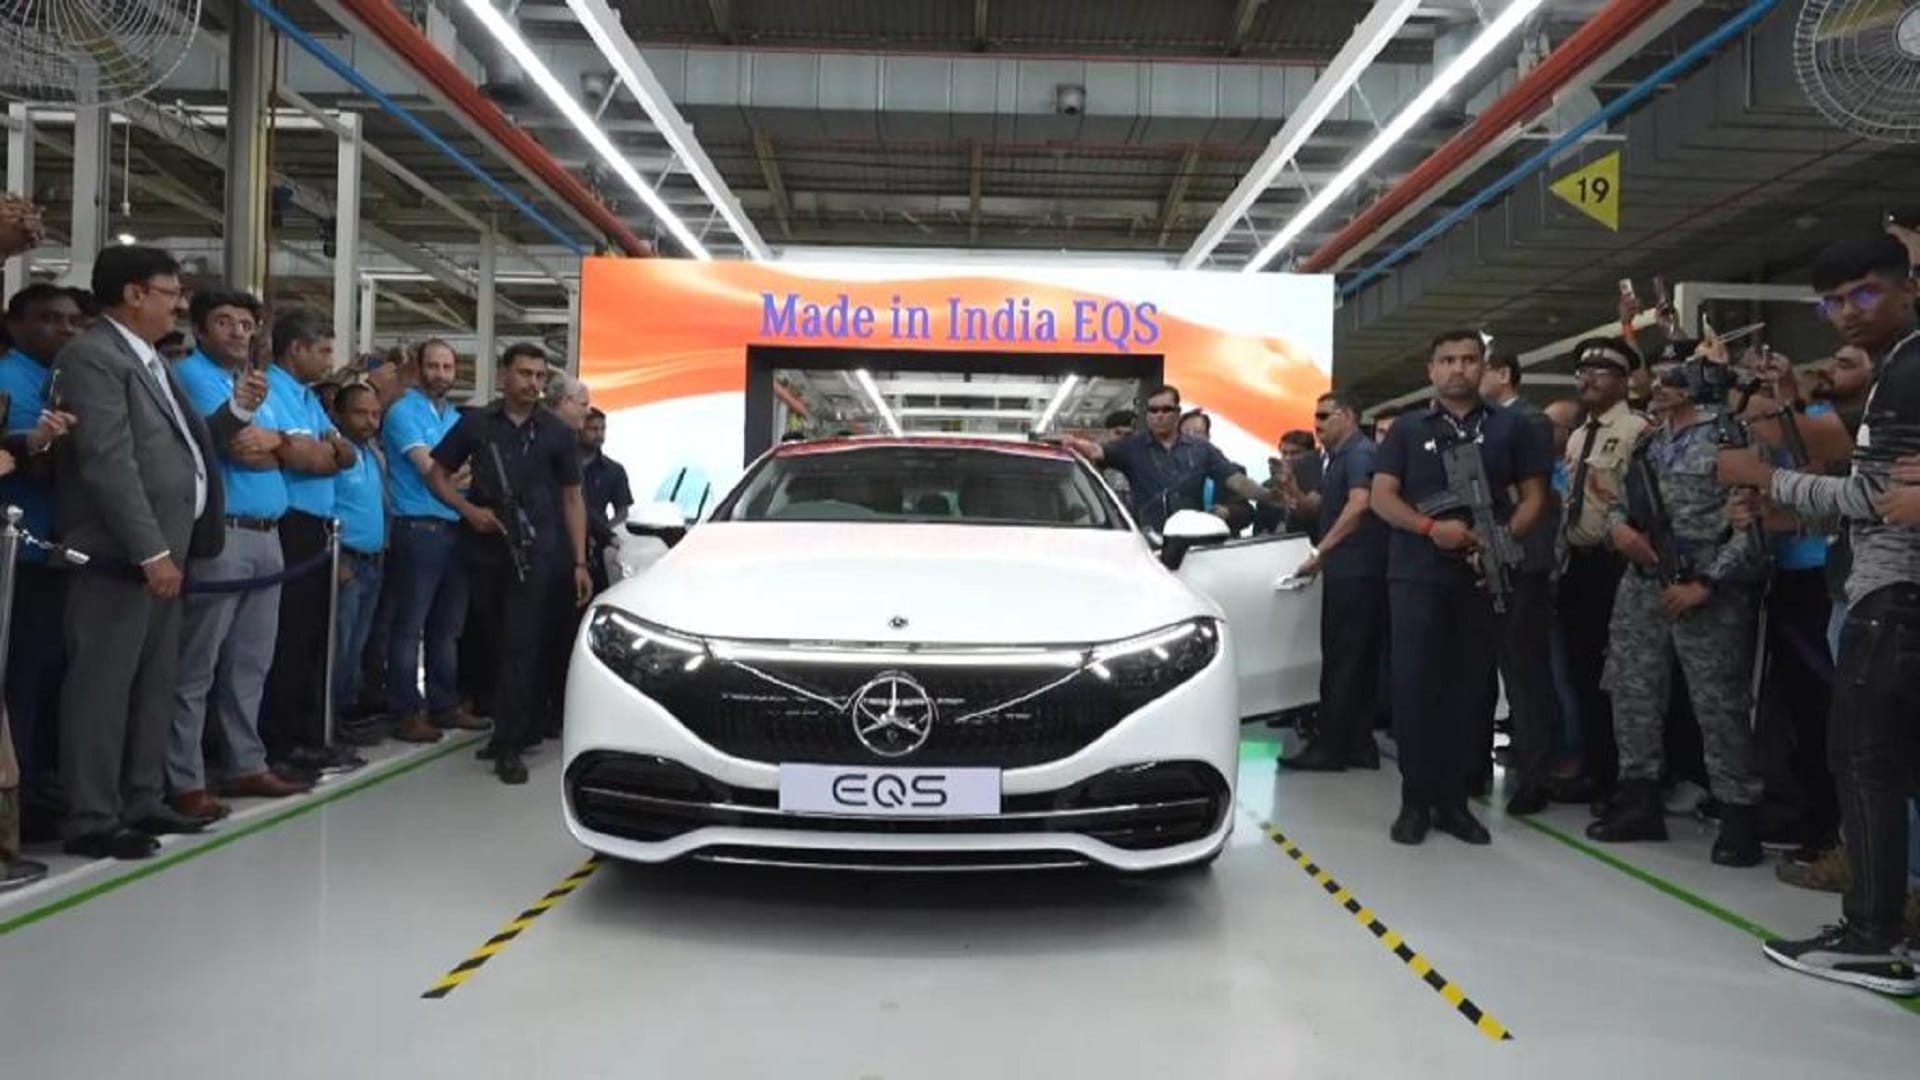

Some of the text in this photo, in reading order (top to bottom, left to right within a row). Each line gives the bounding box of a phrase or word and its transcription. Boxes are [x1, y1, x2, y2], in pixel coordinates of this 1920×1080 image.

[1577, 176, 1610, 203] 19
[760, 293, 1161, 351] Made in India EQS
[832, 773, 948, 808] EQS
